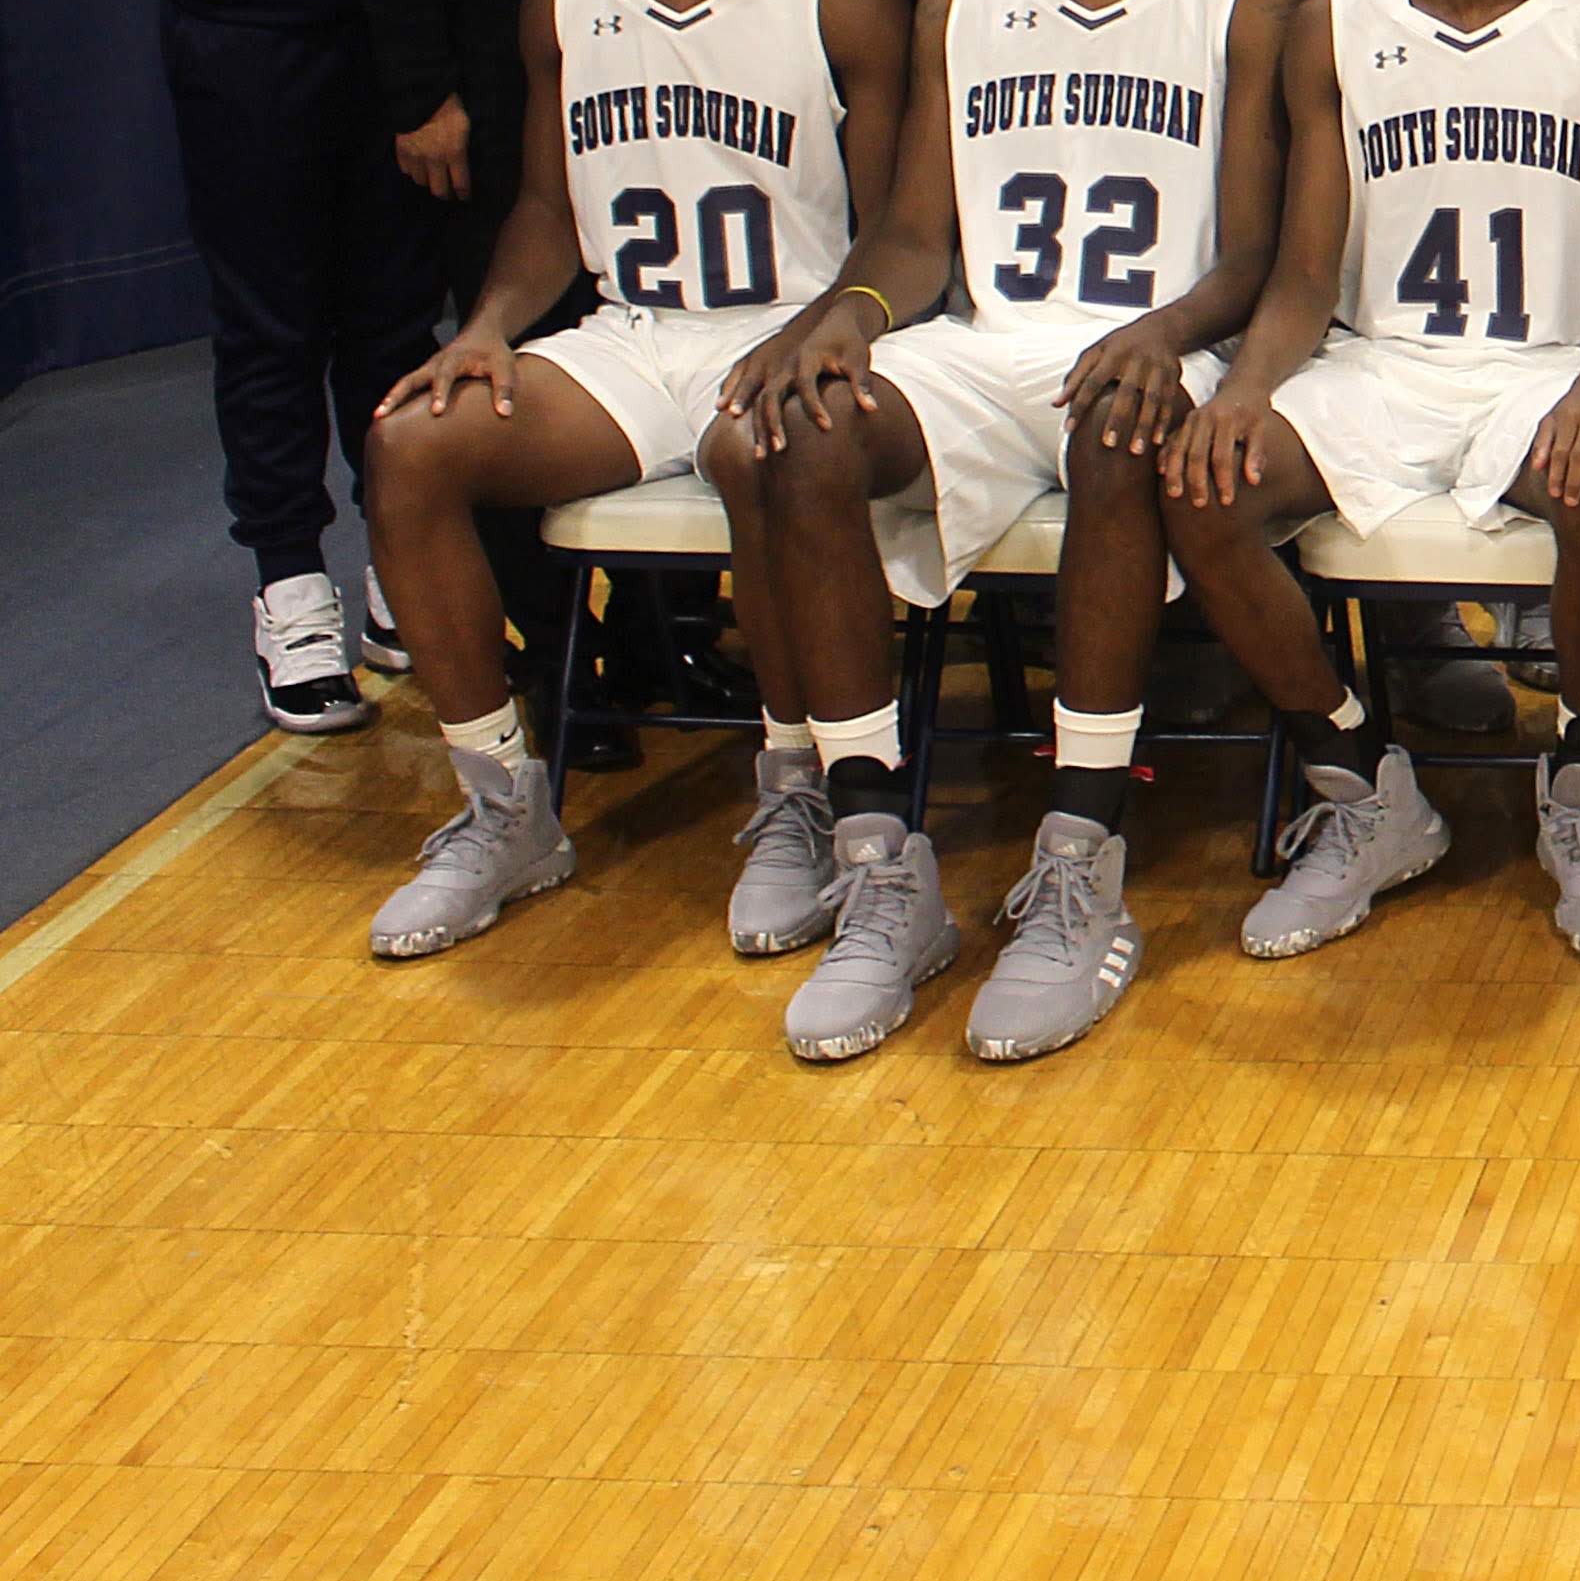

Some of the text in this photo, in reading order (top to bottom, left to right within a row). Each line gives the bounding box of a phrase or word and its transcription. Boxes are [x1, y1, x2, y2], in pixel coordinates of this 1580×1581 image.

[569, 84, 797, 168] SOUTH SUBURBAN
[966, 72, 1204, 148] SOUTH SUBURBAN
[611, 183, 779, 309] 20
[994, 173, 1159, 308] 32
[1397, 207, 1530, 342] 41
